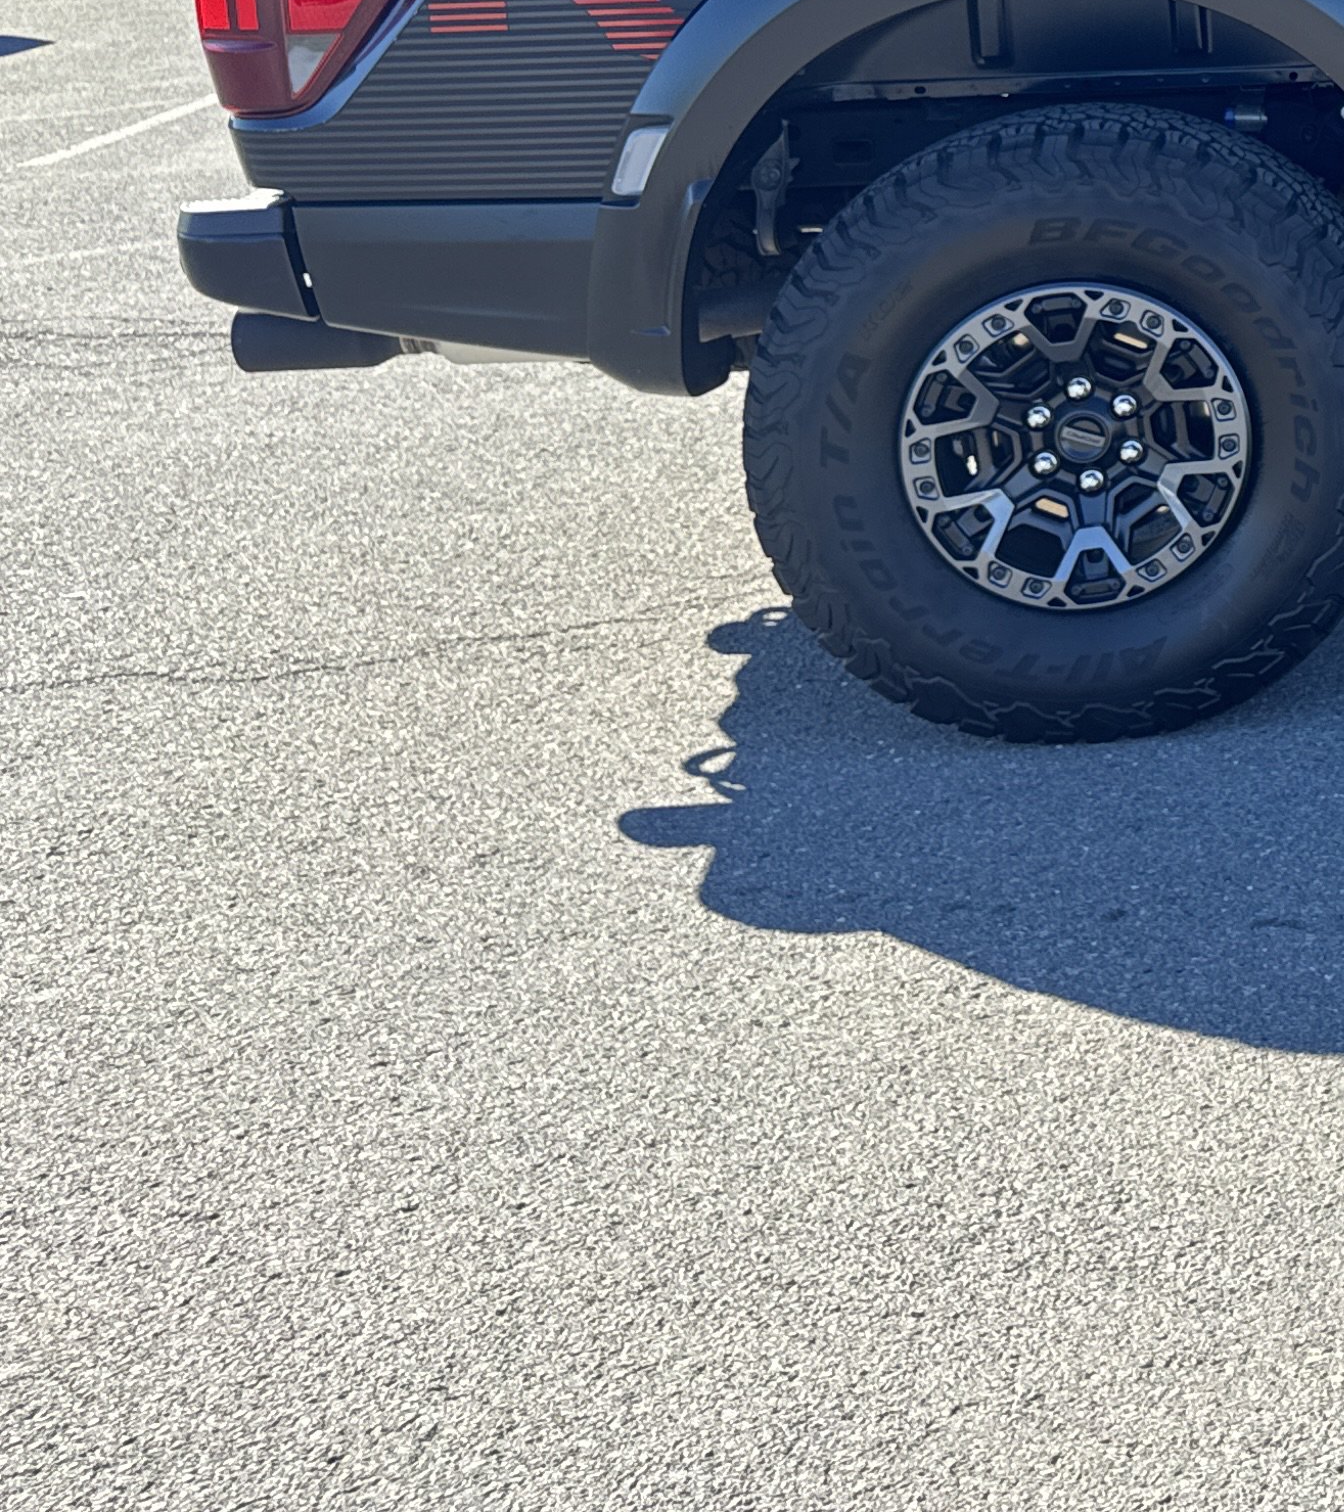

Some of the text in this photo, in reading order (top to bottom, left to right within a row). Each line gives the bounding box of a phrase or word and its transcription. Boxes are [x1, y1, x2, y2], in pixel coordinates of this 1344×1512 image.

[819, 351, 874, 469] T/A
[1028, 216, 1322, 504] BFGoodrich
[832, 494, 1168, 683] All-Terrain
